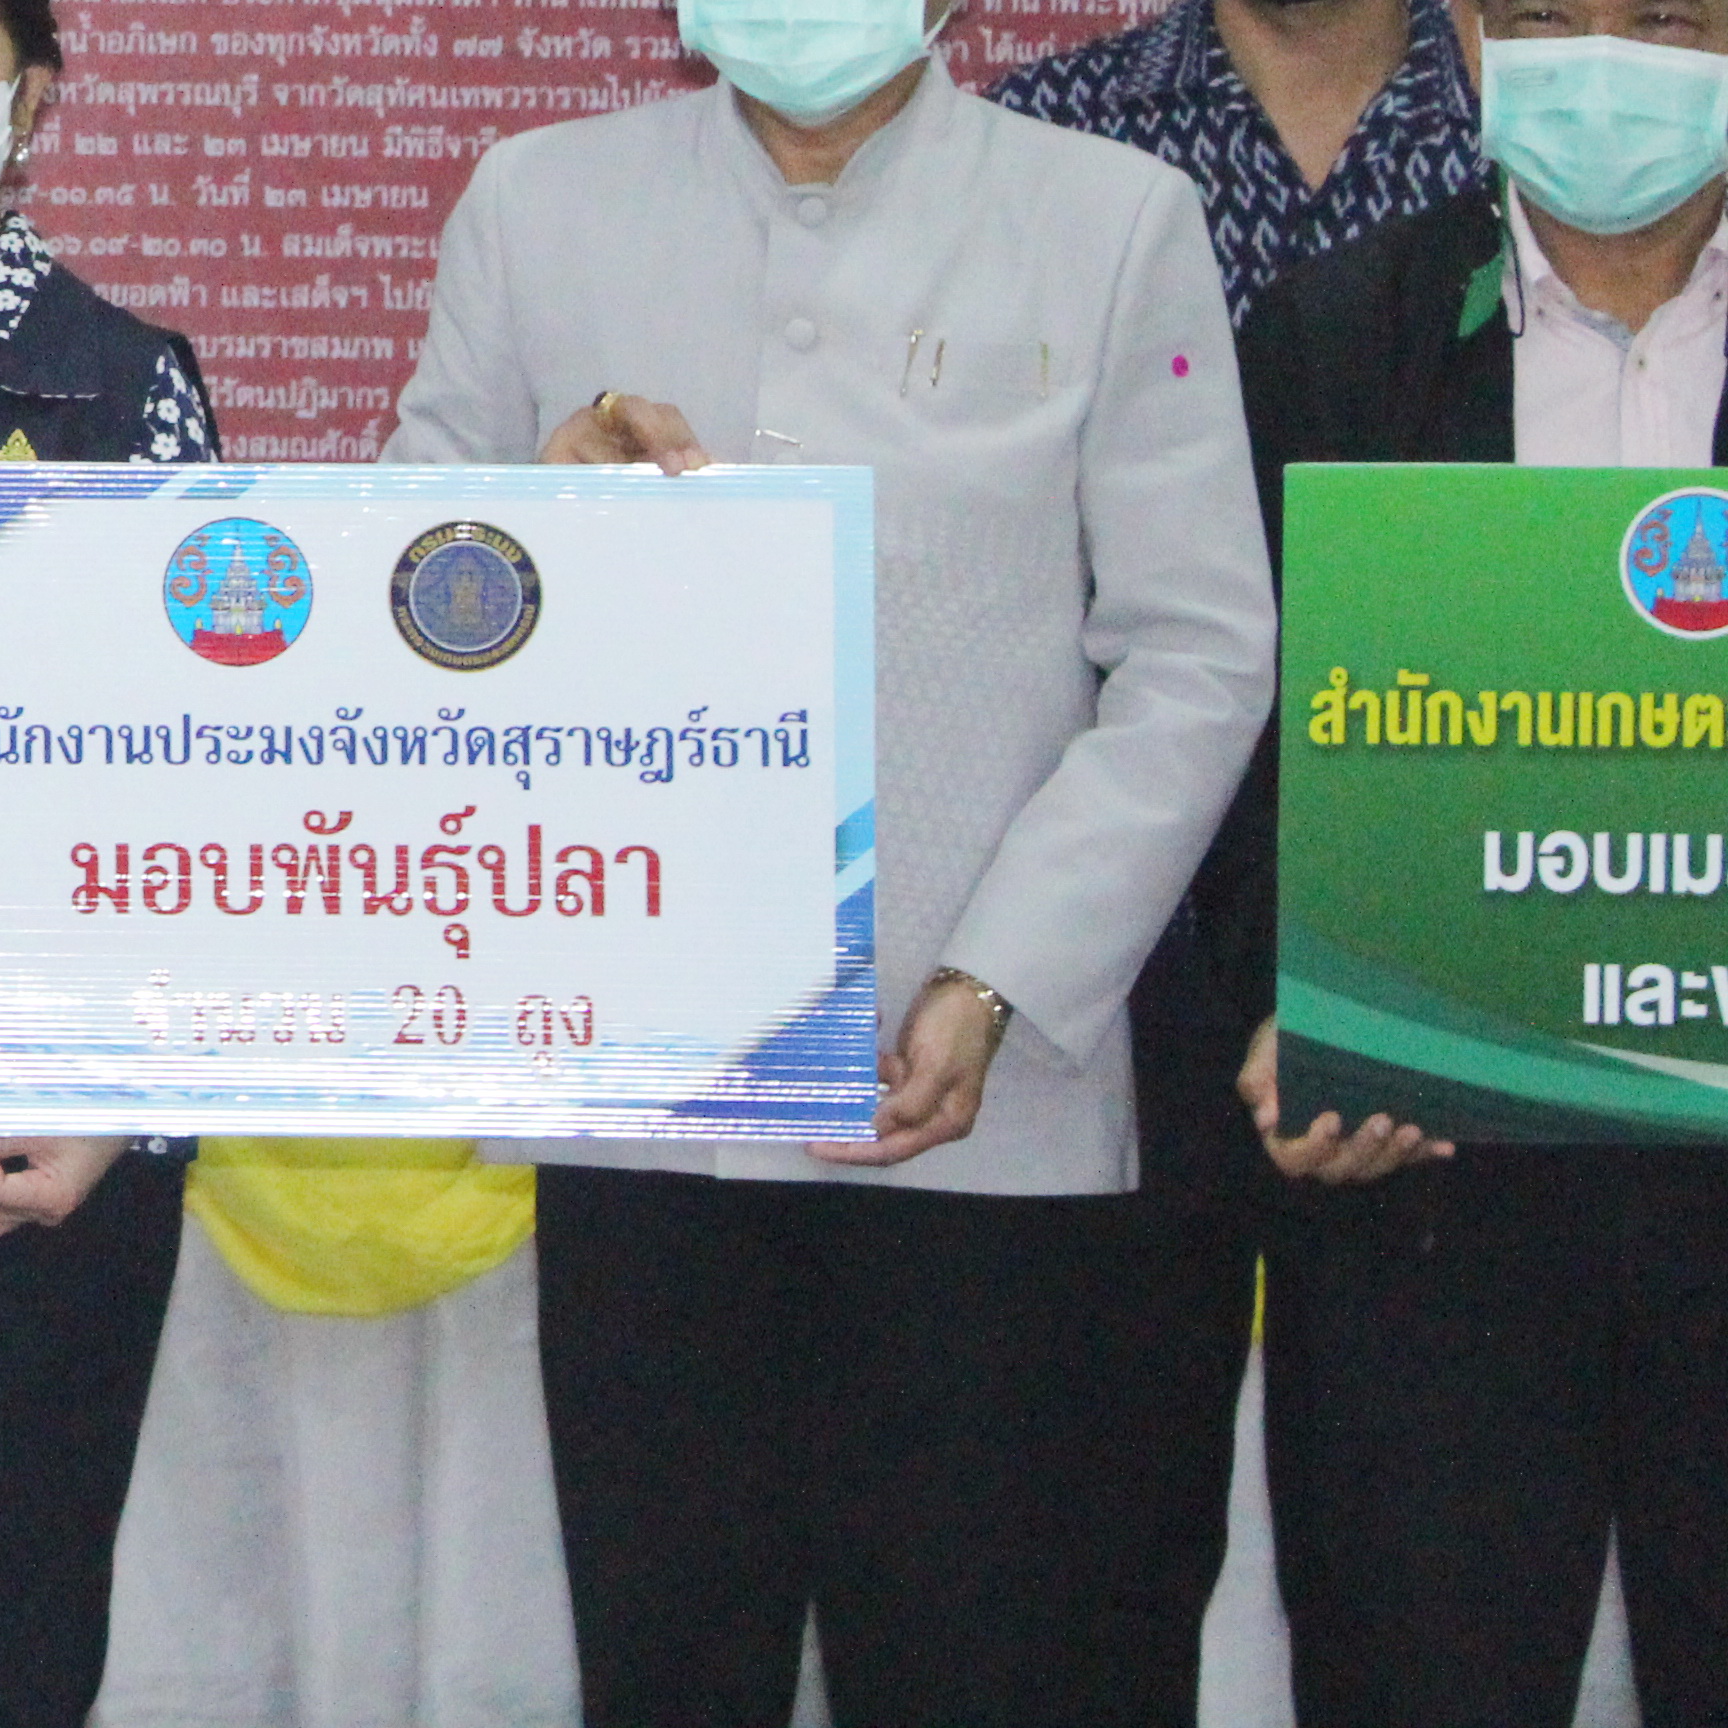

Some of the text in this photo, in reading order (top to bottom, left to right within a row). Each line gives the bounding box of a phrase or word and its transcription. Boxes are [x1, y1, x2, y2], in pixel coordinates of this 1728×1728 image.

[516, 26, 612, 58] จังหวัด
[132, 133, 189, 155] และ
[261, 134, 369, 157] เมษายน
[321, 185, 429, 207] เมษายน
[69, 804, 663, 960] มอบพันธุ์ปลา
[391, 980, 470, 1048] 20
